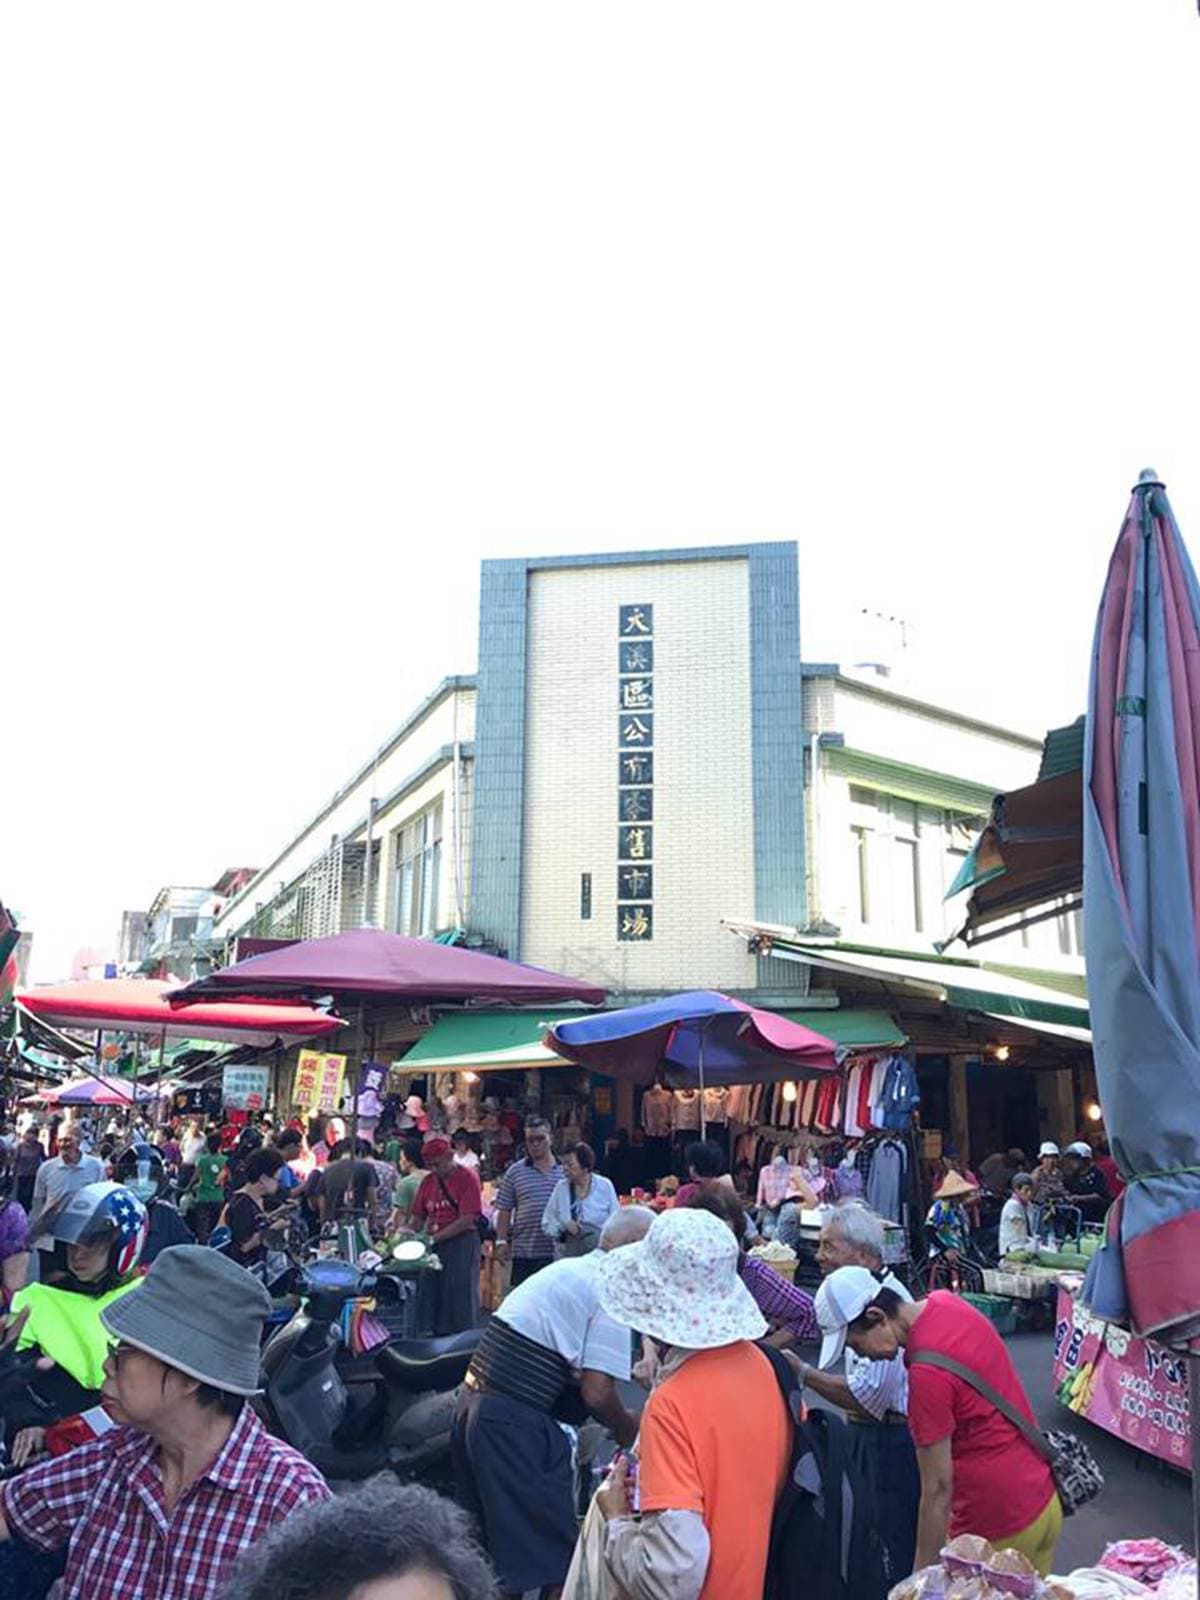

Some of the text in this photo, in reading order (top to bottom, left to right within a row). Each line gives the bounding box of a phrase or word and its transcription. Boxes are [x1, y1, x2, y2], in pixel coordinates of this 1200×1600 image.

[619, 605, 653, 940] 大溪區公有零售市場
